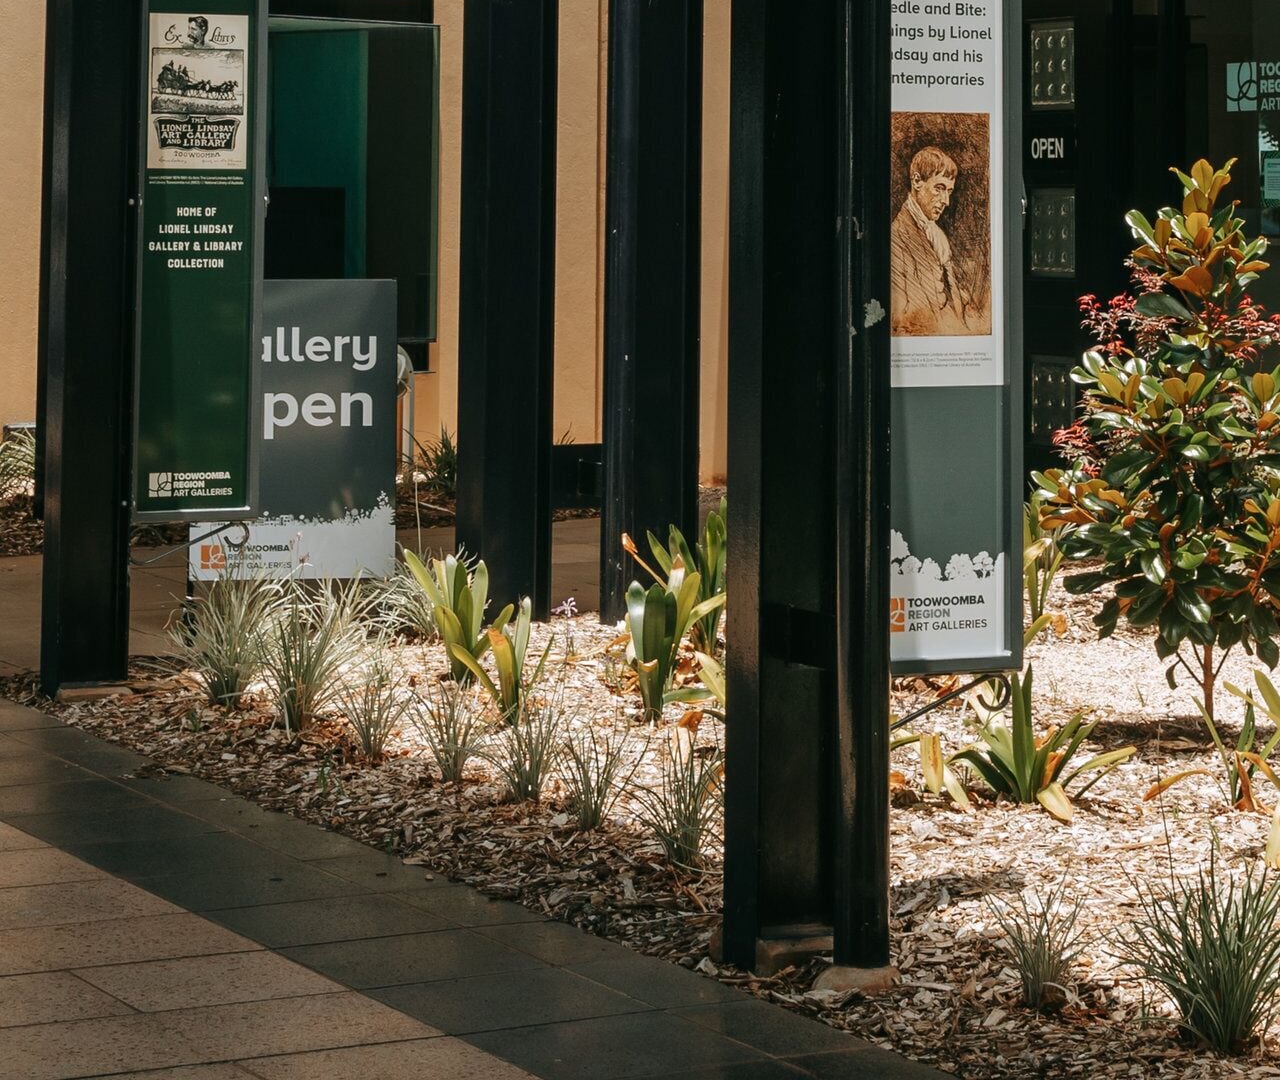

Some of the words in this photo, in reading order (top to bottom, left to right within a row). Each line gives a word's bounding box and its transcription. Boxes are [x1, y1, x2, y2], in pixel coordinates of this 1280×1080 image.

[891, 2, 920, 14] edle
[925, 3, 950, 15] and
[956, 3, 986, 16] Bite:
[165, 24, 183, 44] Ex
[929, 25, 945, 41] by
[950, 26, 992, 40] Lionel
[933, 50, 958, 62] and
[964, 50, 983, 62] his
[892, 73, 984, 88] ntemporaries
[1261, 98, 1280, 110] ART
[161, 124, 193, 132] LIONEL
[183, 139, 227, 147] LIBRARY
[1031, 138, 1063, 158] OPEN
[177, 207, 202, 216] HOME
[205, 207, 217, 216] OF
[159, 225, 190, 233] LIONEL
[194, 225, 233, 233] LINDSAY
[149, 242, 189, 251] GALLERY
[193, 242, 200, 251] &
[204, 242, 243, 251] LIBRARY
[168, 259, 224, 268] COLLECTION
[262, 327, 377, 371] llery
[264, 393, 373, 439] pen
[174, 472, 231, 480] TOOWOOMBA
[173, 480, 205, 488] REGION
[191, 488, 232, 496] GALLERIES
[908, 595, 984, 608] TOOWOOMBA
[908, 609, 950, 619] REGION
[909, 622, 929, 632] ART
[932, 619, 987, 630] GALLERIES
